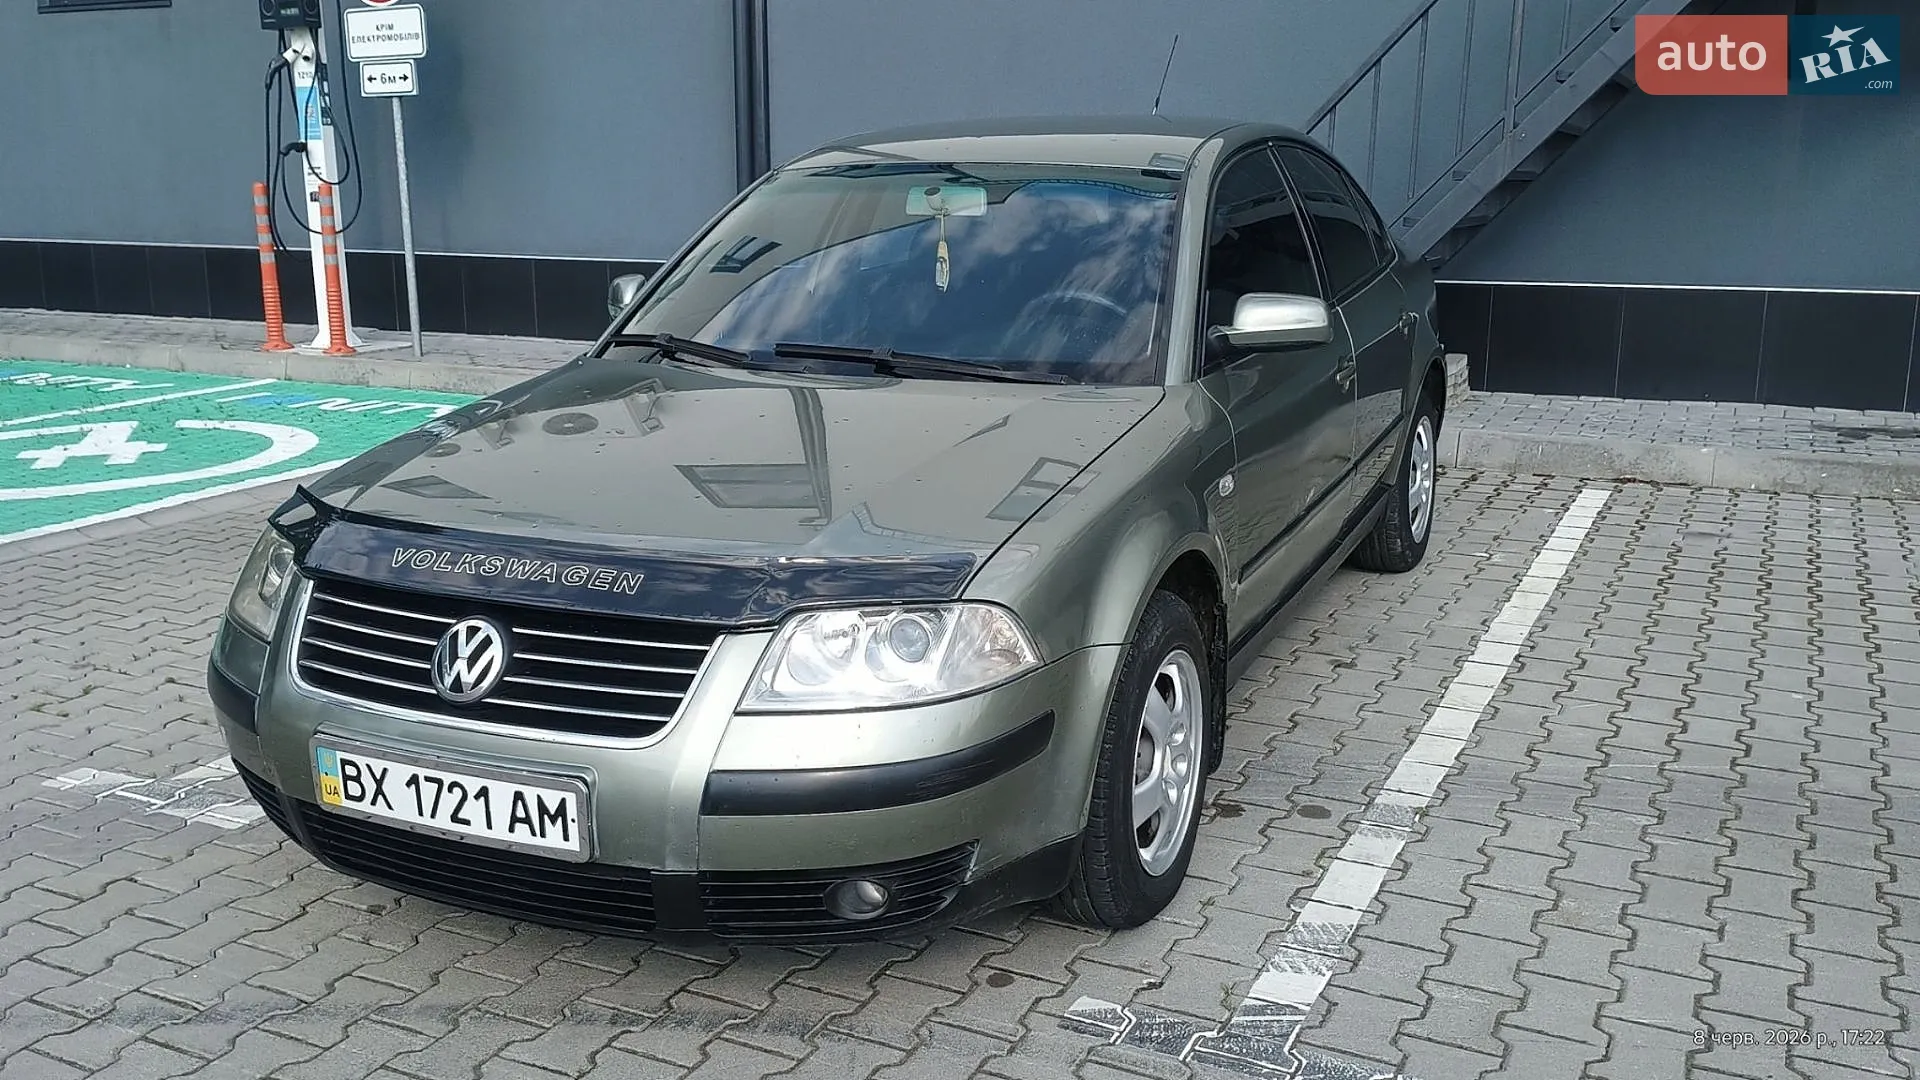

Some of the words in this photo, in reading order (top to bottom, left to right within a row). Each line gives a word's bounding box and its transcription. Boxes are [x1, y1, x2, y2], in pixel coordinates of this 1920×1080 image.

[391, 547, 645, 595] VOLKSWAGEN
[324, 782, 340, 799] UA
[405, 773, 493, 831] 1721
